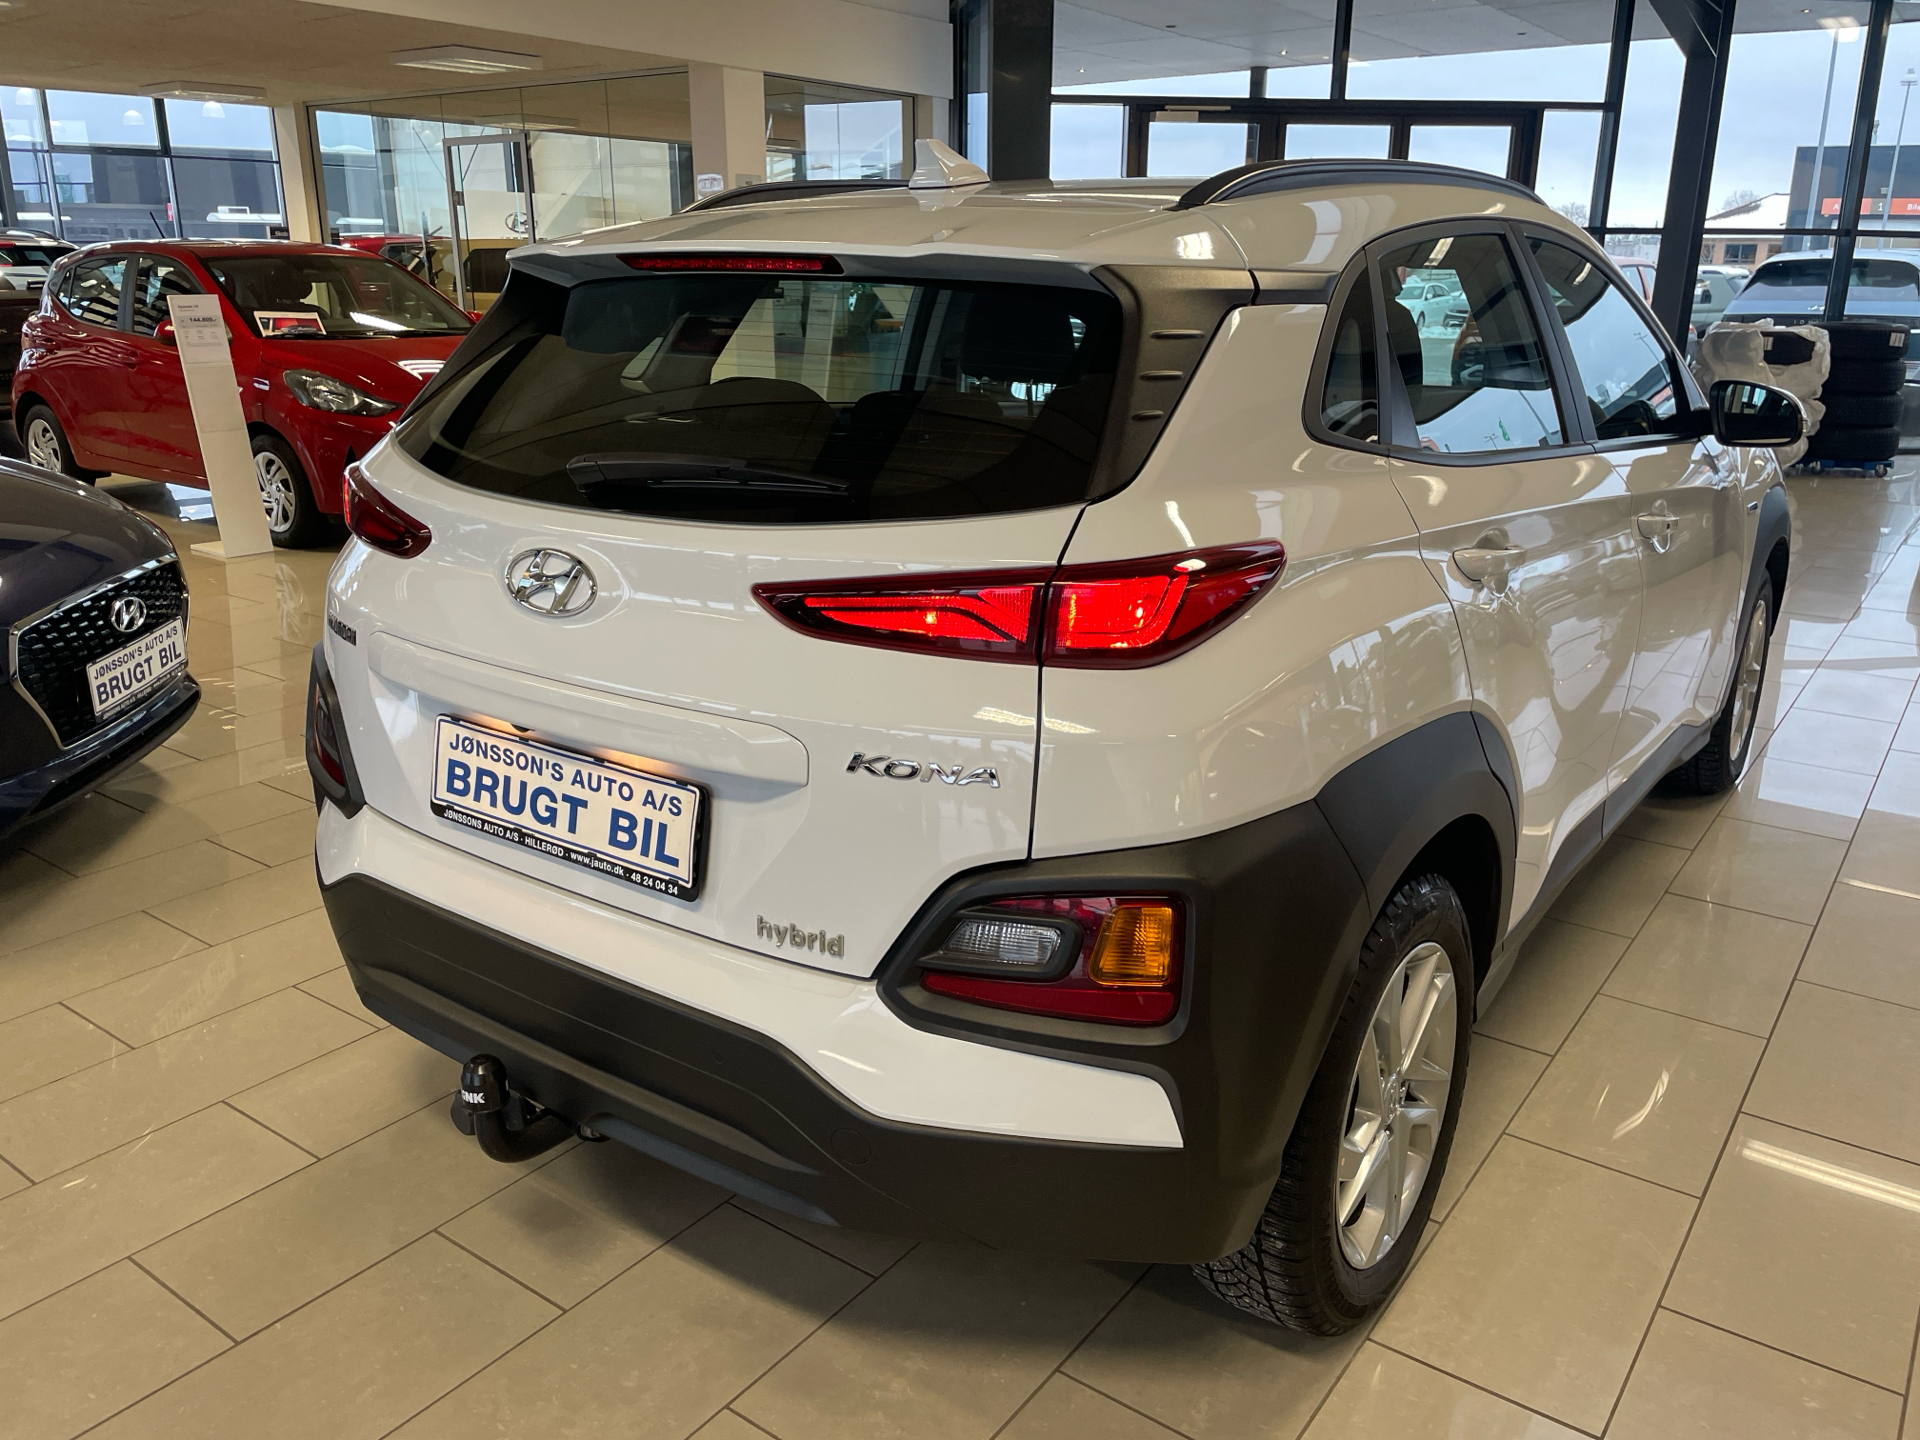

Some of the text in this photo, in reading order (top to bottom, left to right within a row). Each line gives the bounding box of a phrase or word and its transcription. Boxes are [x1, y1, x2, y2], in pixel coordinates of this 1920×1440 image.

[93, 625, 178, 681] JØNSSON'S AUTO A/S
[96, 655, 153, 706] BRUGT
[158, 641, 182, 669] BIL
[449, 733, 683, 817] JØNSSON'S AUTO A/S
[845, 751, 1001, 789] KONA
[446, 758, 680, 868] BRUGT BIL
[443, 809, 482, 830] JØNSSONS
[483, 822, 504, 837] AUTO
[505, 828, 519, 842] A/S
[524, 836, 564, 857] HILLERØD
[570, 851, 625, 877] www.jauto.dk
[631, 872, 641, 883] 48
[642, 876, 654, 888] 24
[655, 880, 666, 892] 04
[667, 884, 678, 895] 34
[756, 914, 845, 958] hybrid
